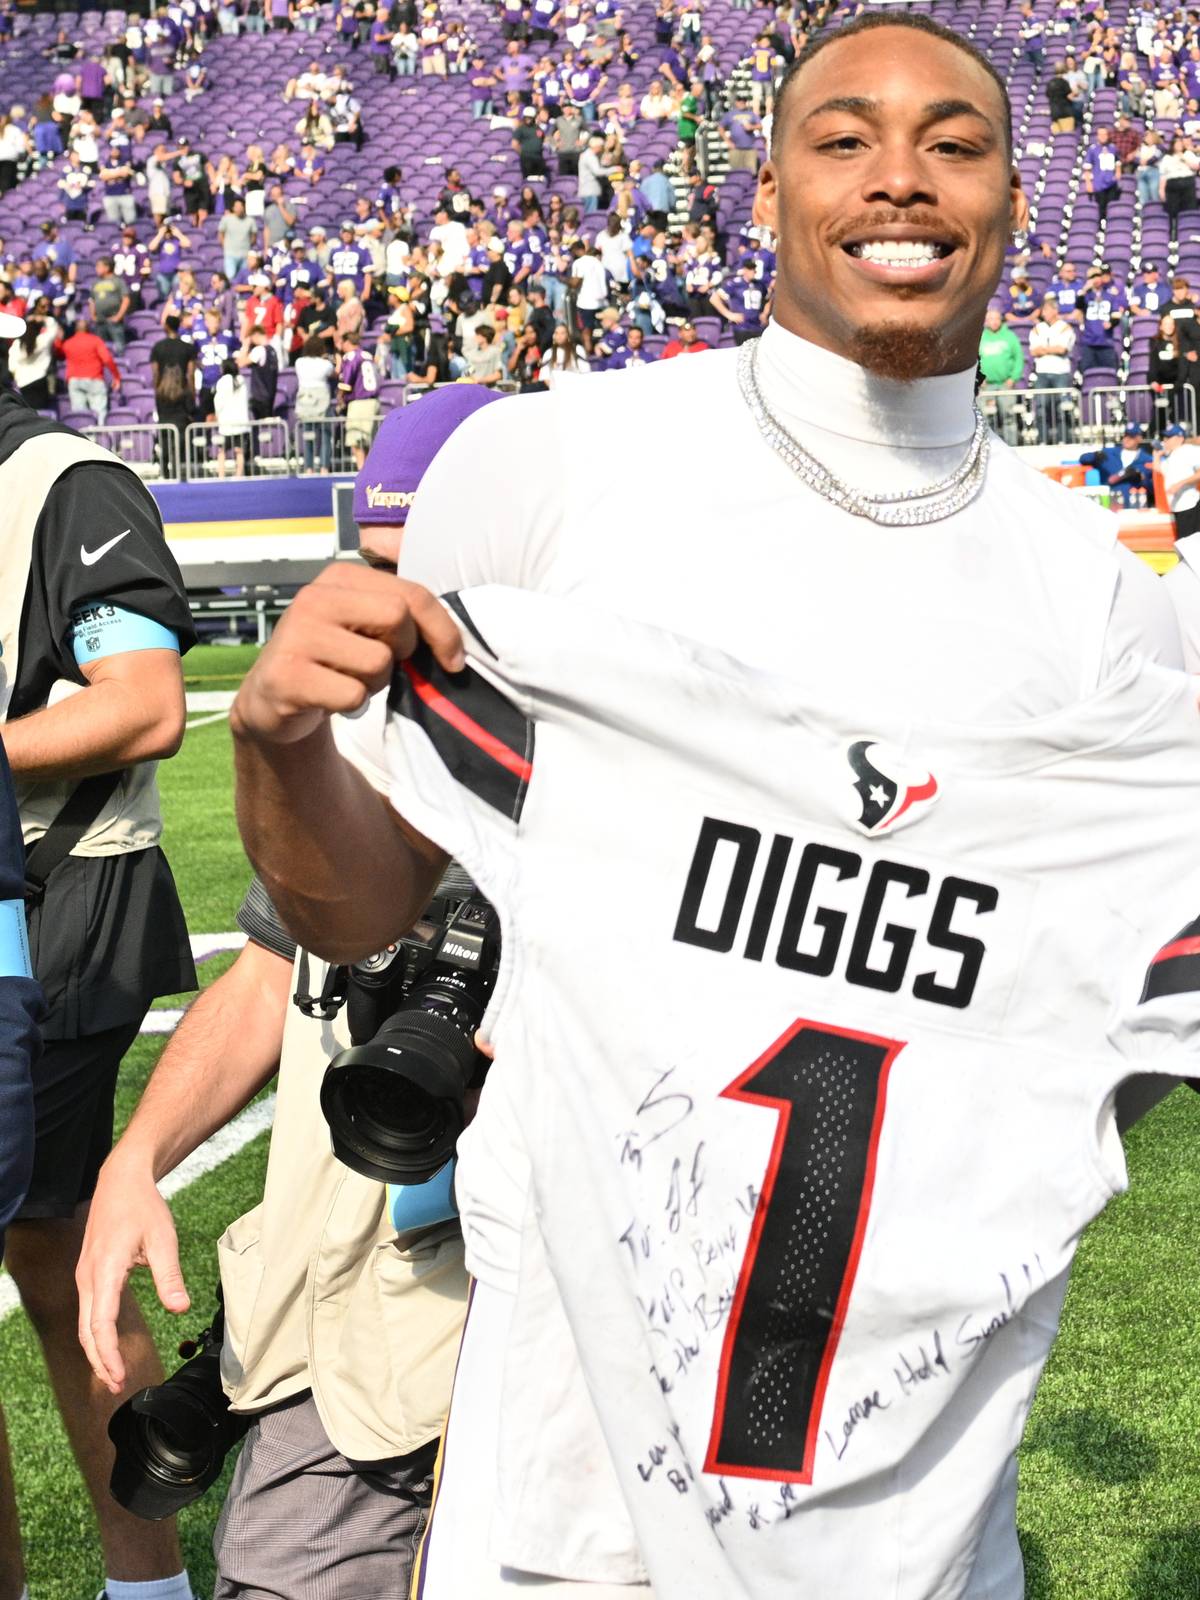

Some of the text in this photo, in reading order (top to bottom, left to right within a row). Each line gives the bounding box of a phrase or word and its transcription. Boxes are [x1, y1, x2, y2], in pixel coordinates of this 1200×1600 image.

[254, 307, 267, 324] 7
[72, 604, 103, 627] EEK
[672, 816, 999, 1009] DIGGS
[442, 942, 479, 961] Nikon
[702, 1017, 909, 1485] 1
